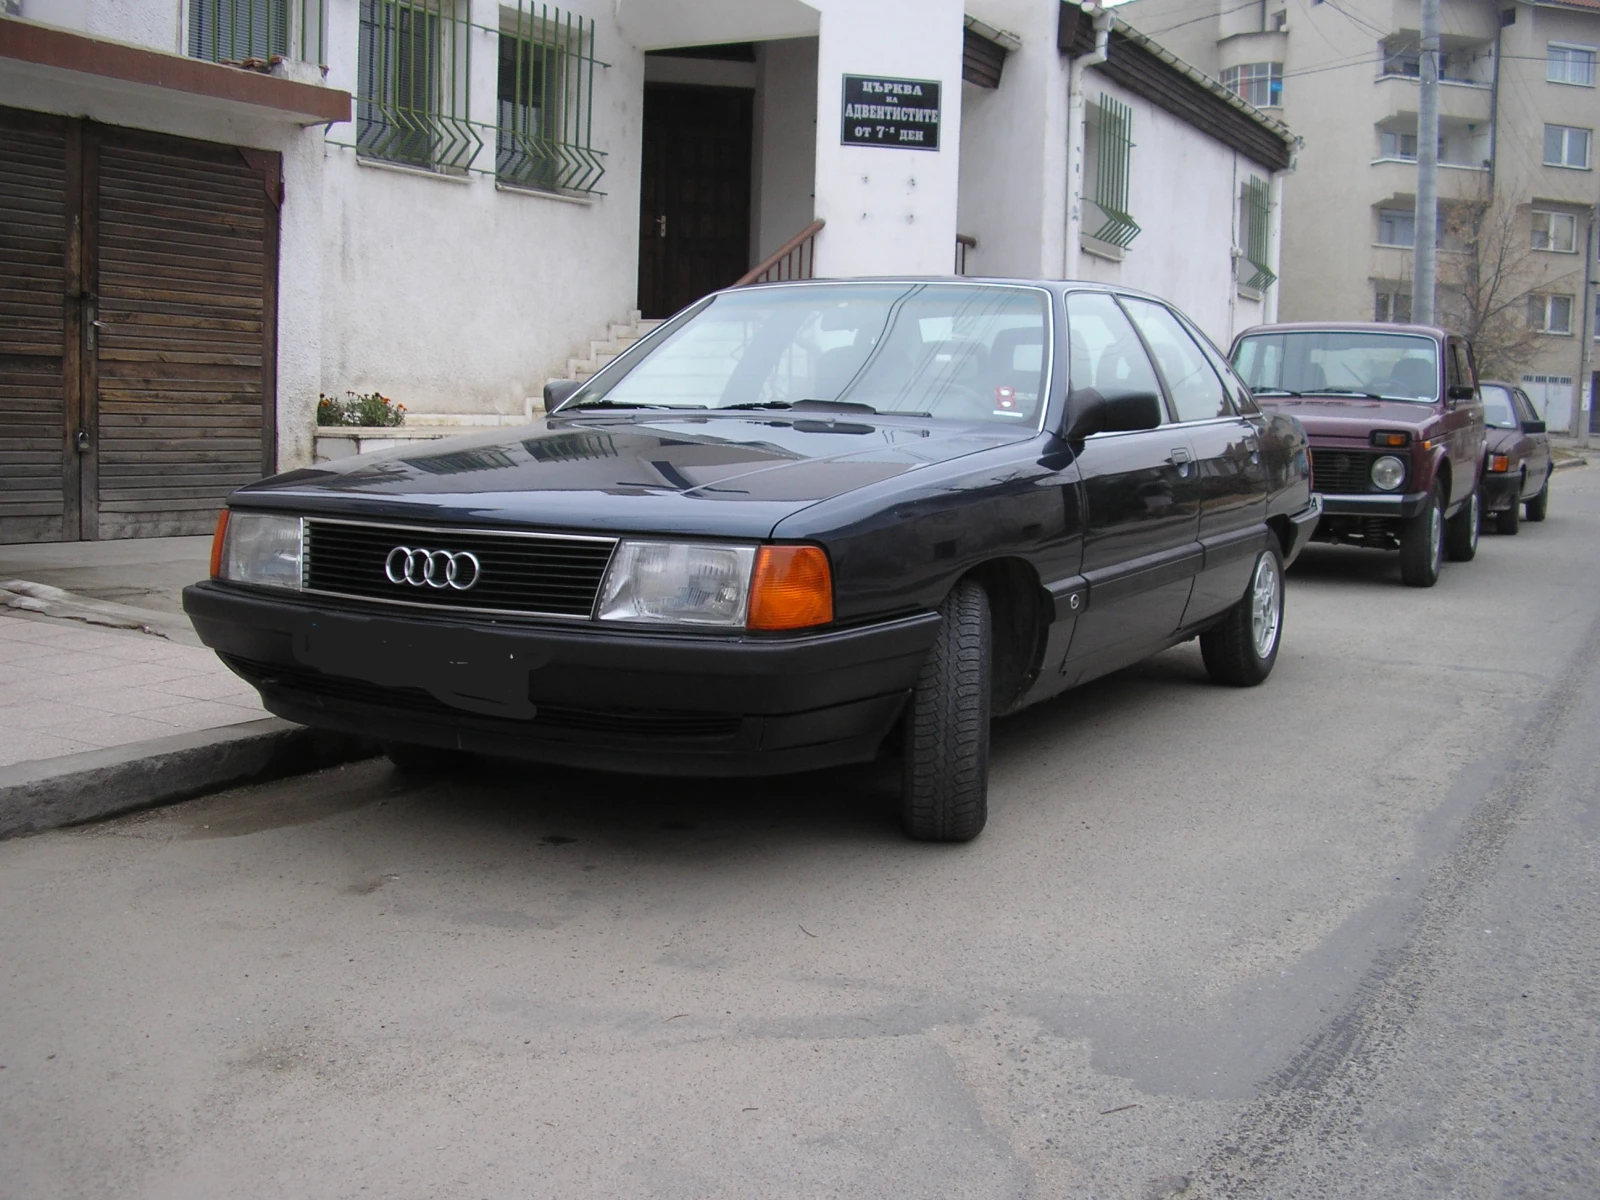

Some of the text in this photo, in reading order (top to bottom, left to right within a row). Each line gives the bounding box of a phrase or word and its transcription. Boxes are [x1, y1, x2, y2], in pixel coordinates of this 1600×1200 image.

[862, 81, 922, 95] ЦЪРКВА
[845, 103, 938, 123] АДВЕНТИСТИТЕ
[854, 126, 871, 137] ОТ
[899, 129, 924, 141] ДЕН
